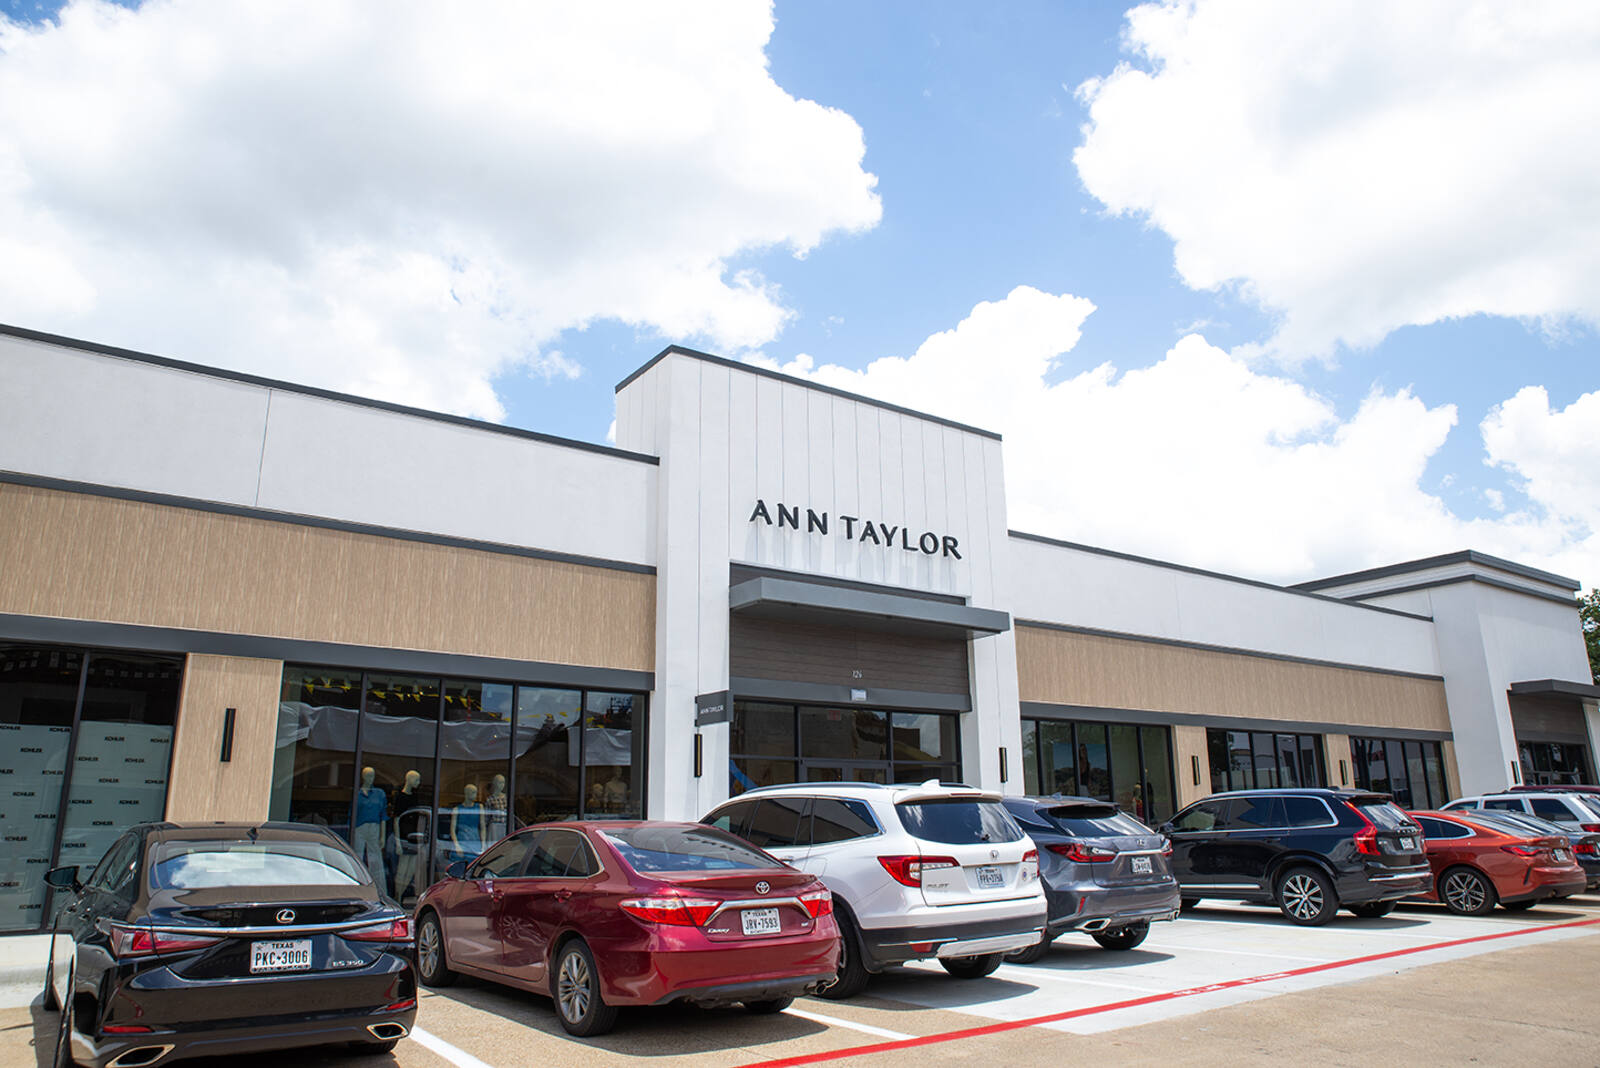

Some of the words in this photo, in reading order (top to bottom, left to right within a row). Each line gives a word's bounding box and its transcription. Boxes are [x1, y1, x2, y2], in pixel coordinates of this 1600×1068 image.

[749, 499, 828, 536] ANN
[839, 515, 962, 560] TAYLOR
[348, 959, 365, 967] 350
